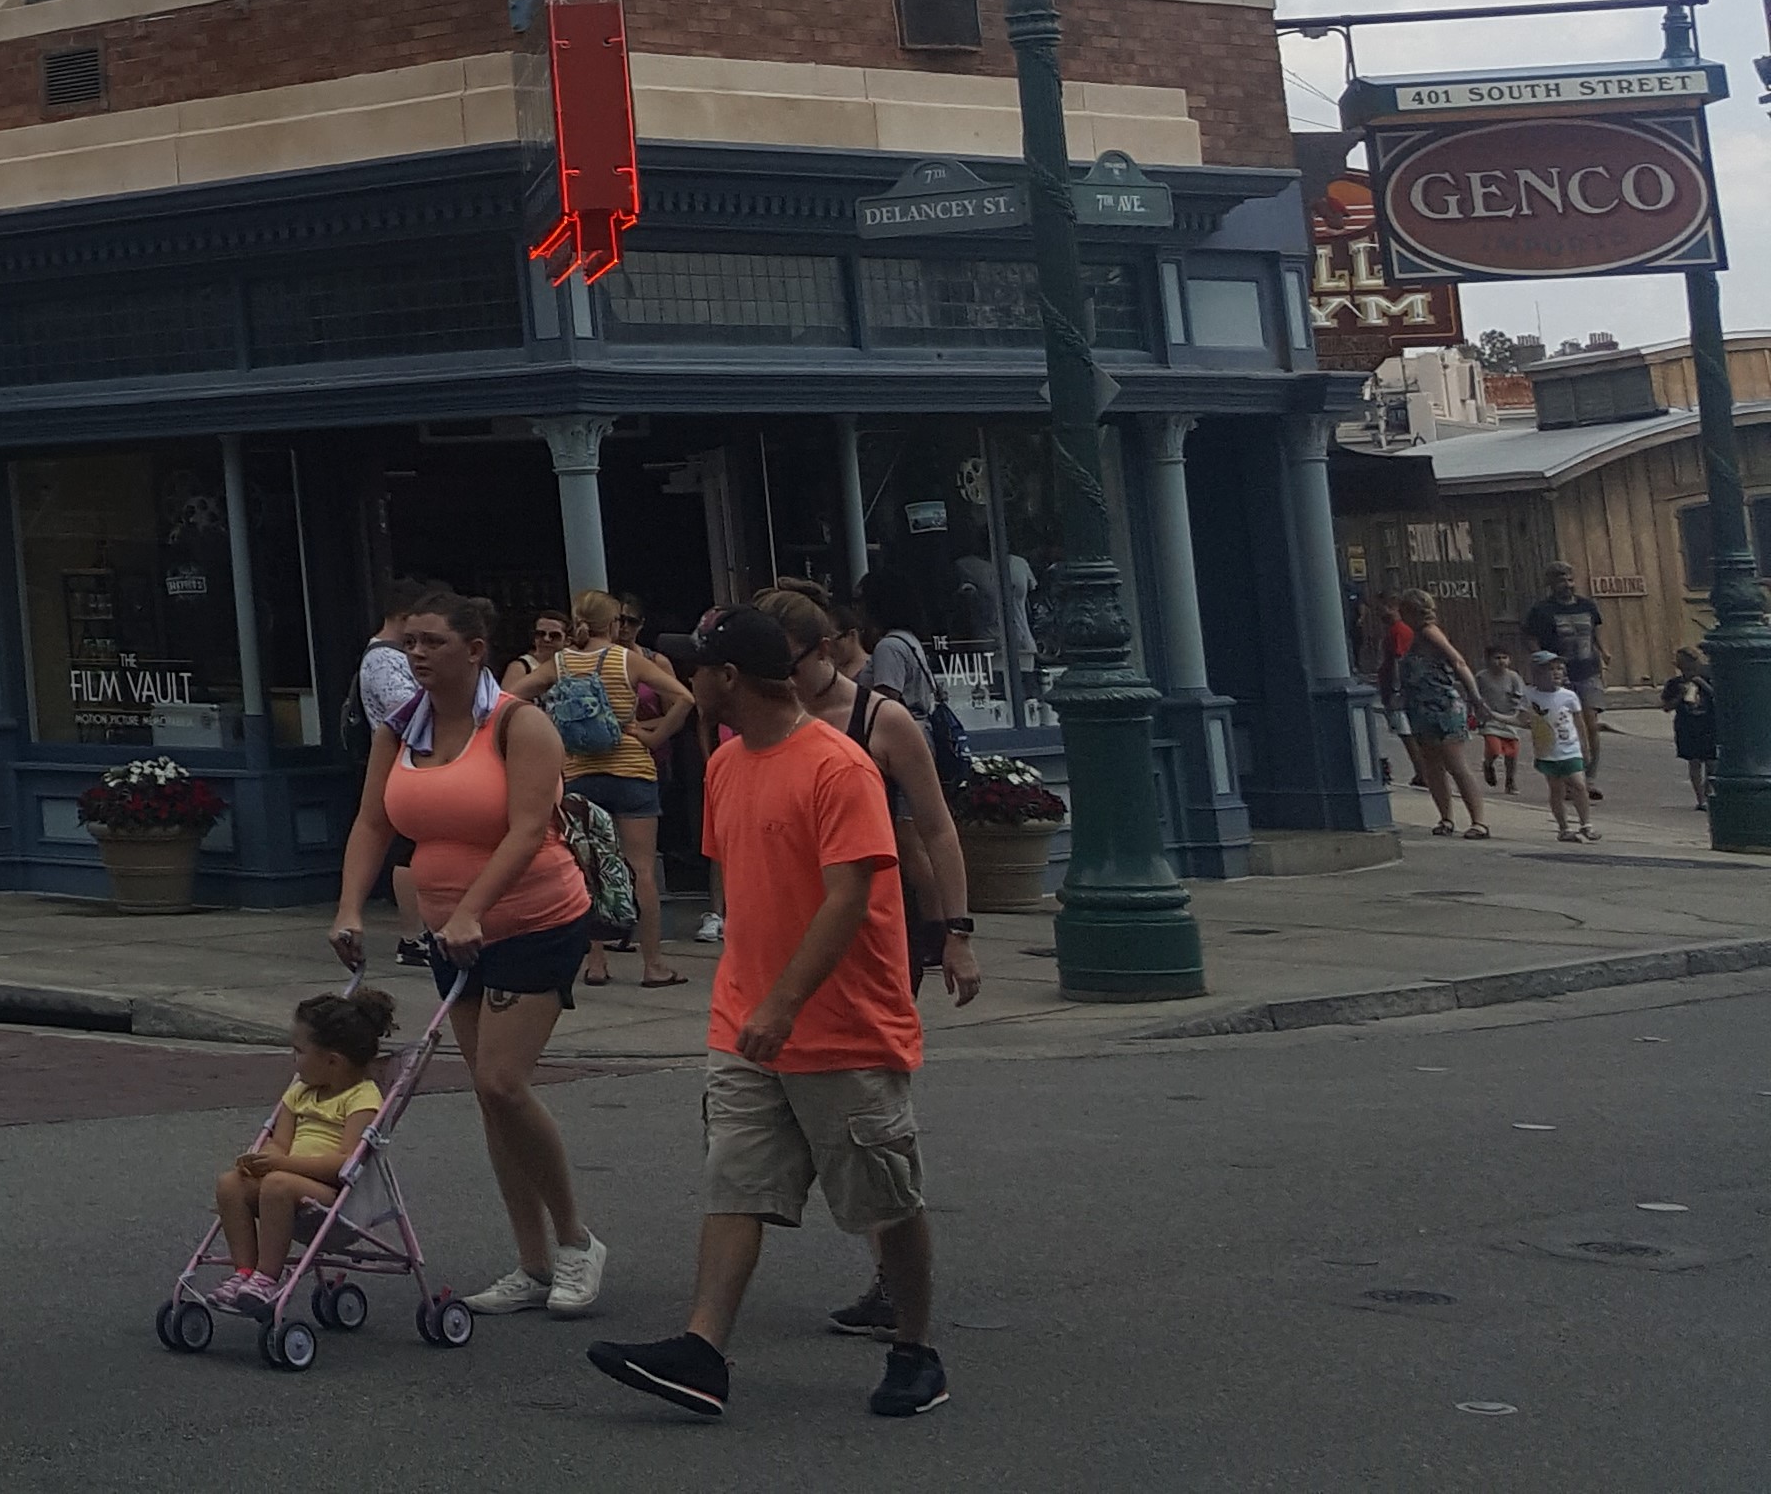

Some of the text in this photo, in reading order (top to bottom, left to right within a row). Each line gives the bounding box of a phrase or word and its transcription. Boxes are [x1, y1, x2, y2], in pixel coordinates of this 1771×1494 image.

[1411, 75, 1692, 106] 401 SOUTH STREET
[924, 169, 946, 184] 7TH
[1409, 164, 1676, 220] GENCO
[864, 196, 1015, 226] DELANCEY ST.
[1593, 576, 1645, 595] LOADING
[933, 635, 949, 650] THE
[119, 653, 137, 668] THE
[938, 652, 995, 686] VAULT
[70, 670, 192, 704] FILM VAULT
